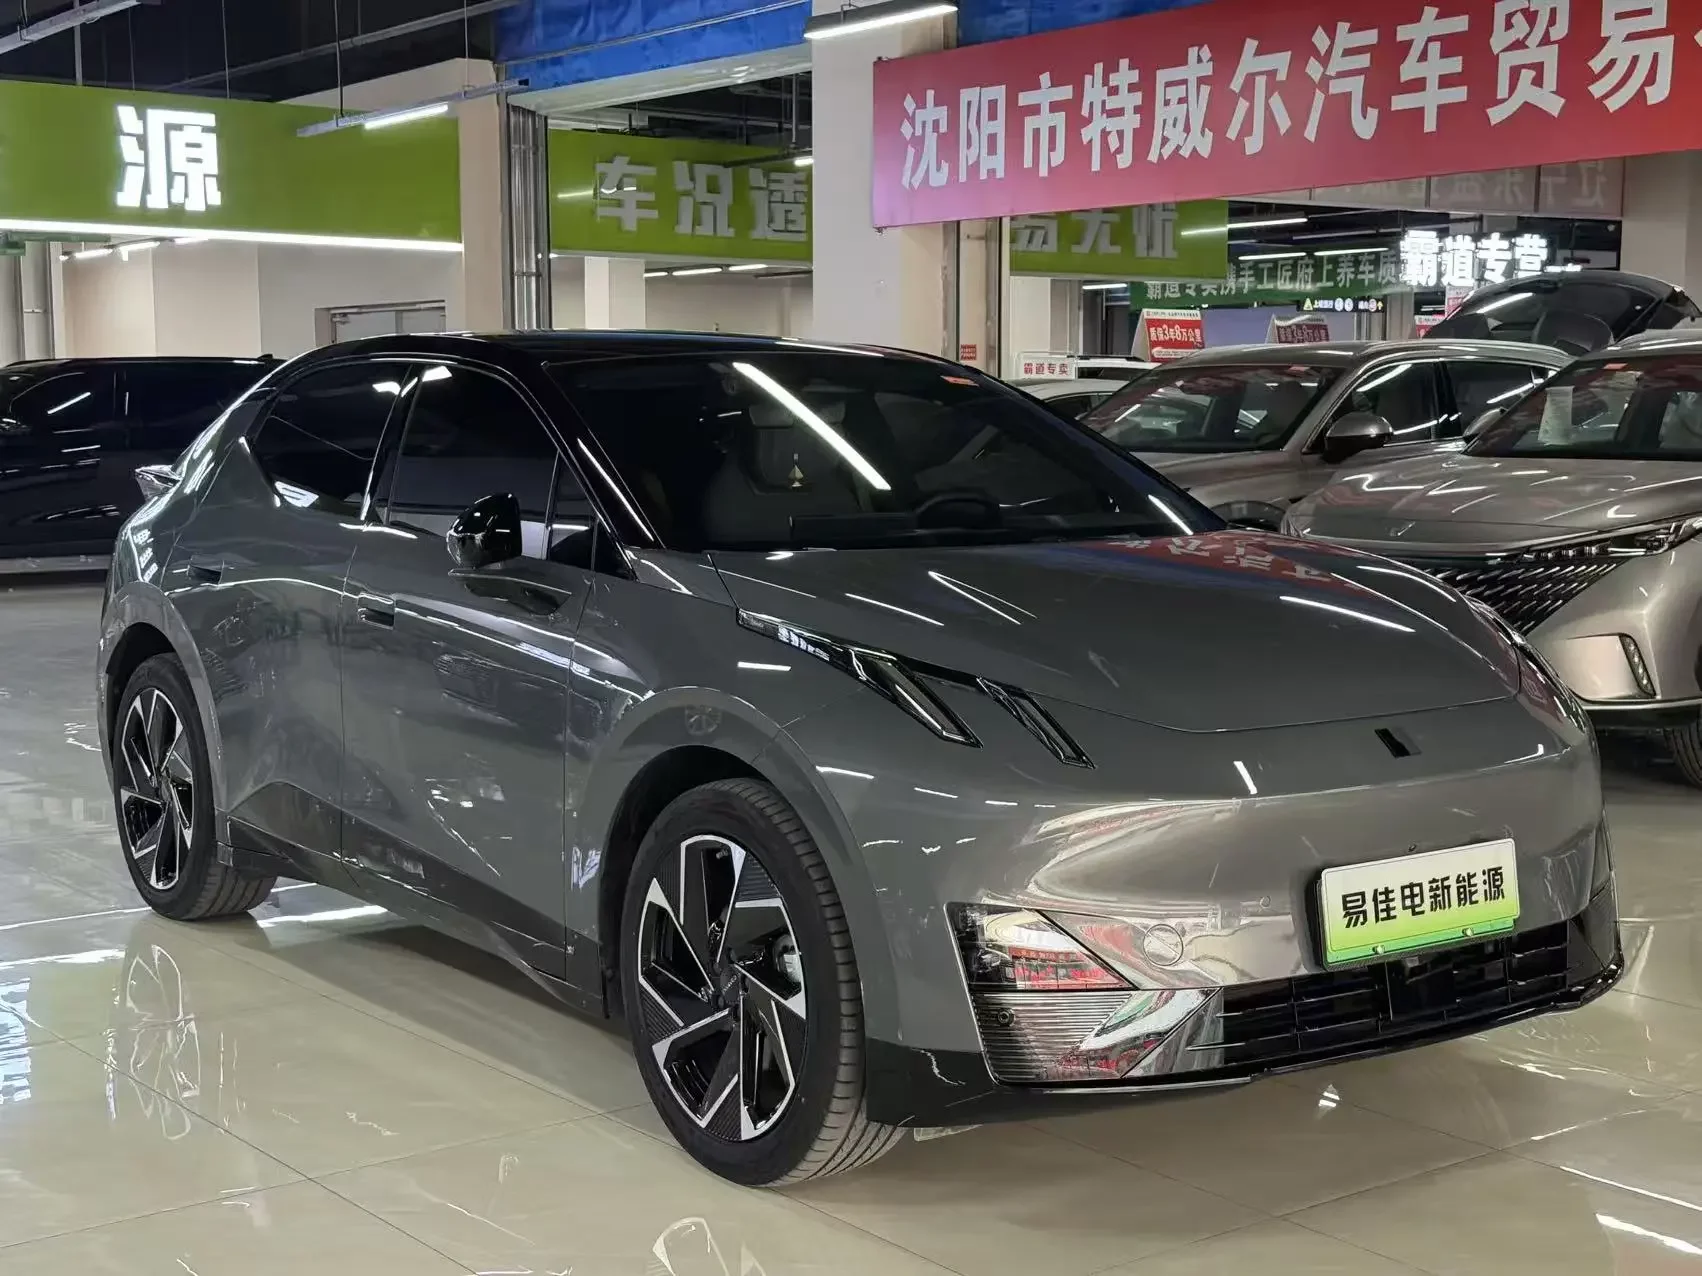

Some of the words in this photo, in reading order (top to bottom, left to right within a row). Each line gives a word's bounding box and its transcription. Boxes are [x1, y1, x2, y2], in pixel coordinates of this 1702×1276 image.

[900, 0, 1702, 190] 沈阳市特威尔汽车贸易
[116, 105, 222, 212] 源
[595, 155, 808, 242] 车况透
[1023, 361, 1070, 376] 霸道专卖
[1149, 323, 1203, 343] 质保3年8万公里
[1341, 866, 1506, 929] 易佳电新能源
